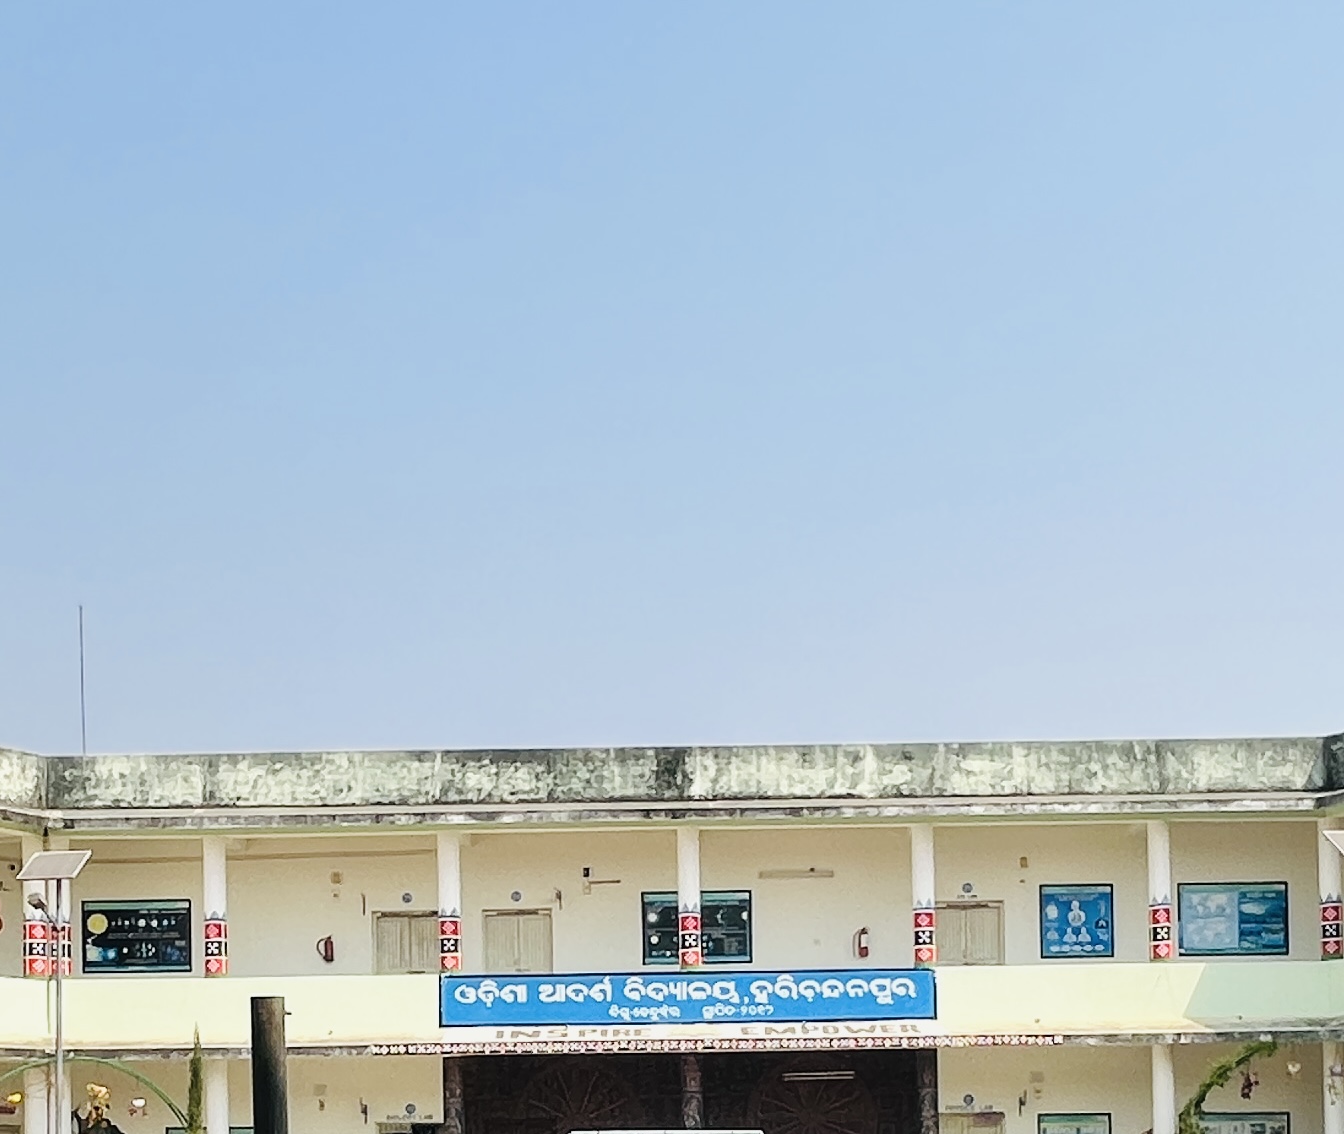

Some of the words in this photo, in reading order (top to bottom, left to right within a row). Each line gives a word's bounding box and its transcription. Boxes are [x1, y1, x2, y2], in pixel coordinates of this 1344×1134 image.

[453, 979, 529, 1008] ଓଡ଼ିଶା
[537, 976, 613, 1004] ଆଦର୍ଶ
[495, 1026, 652, 1039] INSPIRE
[740, 1021, 921, 1036] EMPOWER
